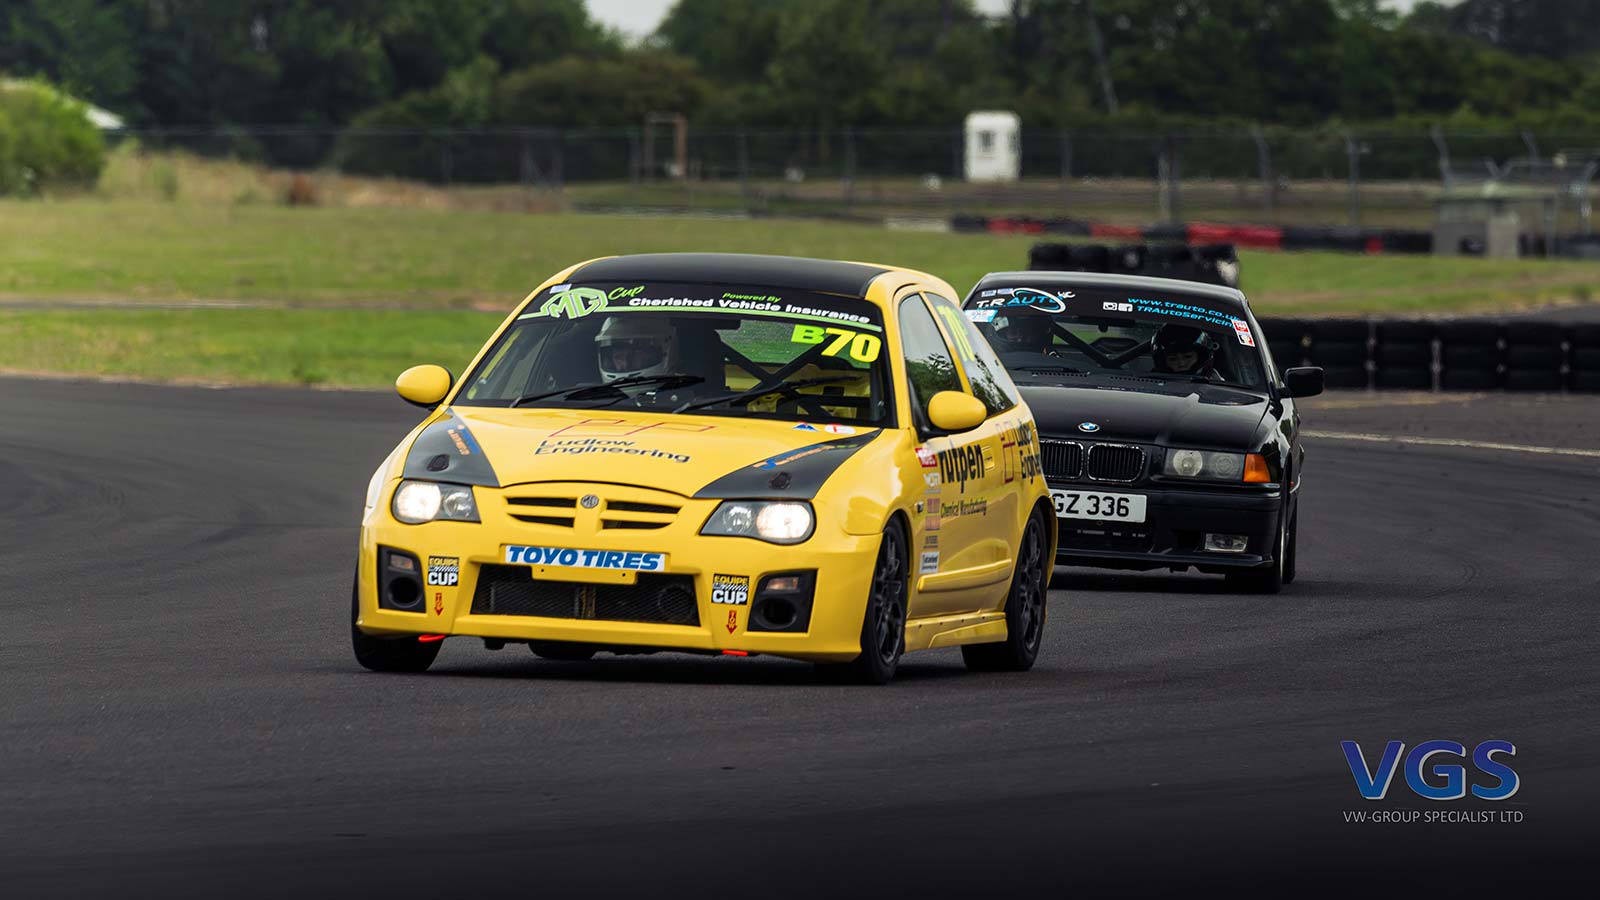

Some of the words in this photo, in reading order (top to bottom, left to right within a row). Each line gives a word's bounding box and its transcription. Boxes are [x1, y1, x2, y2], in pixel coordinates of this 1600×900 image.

[541, 287, 608, 319] MG
[722, 292, 766, 301] Powered
[766, 295, 782, 303] By
[628, 297, 714, 307] Cherished
[718, 299, 781, 312] Vehicle
[785, 304, 871, 323] Insurance
[1136, 305, 1235, 329] TRAutoServicin
[791, 324, 881, 363] B70
[540, 438, 636, 447] Ludlow
[534, 446, 691, 463] Engineering
[938, 444, 985, 494] rutpen
[1086, 495, 1130, 517] 336
[508, 546, 579, 566] TOYO
[582, 550, 661, 570] TIRES
[428, 572, 458, 586] CUP
[714, 575, 748, 585] EQUIPE
[712, 590, 747, 605] CUP
